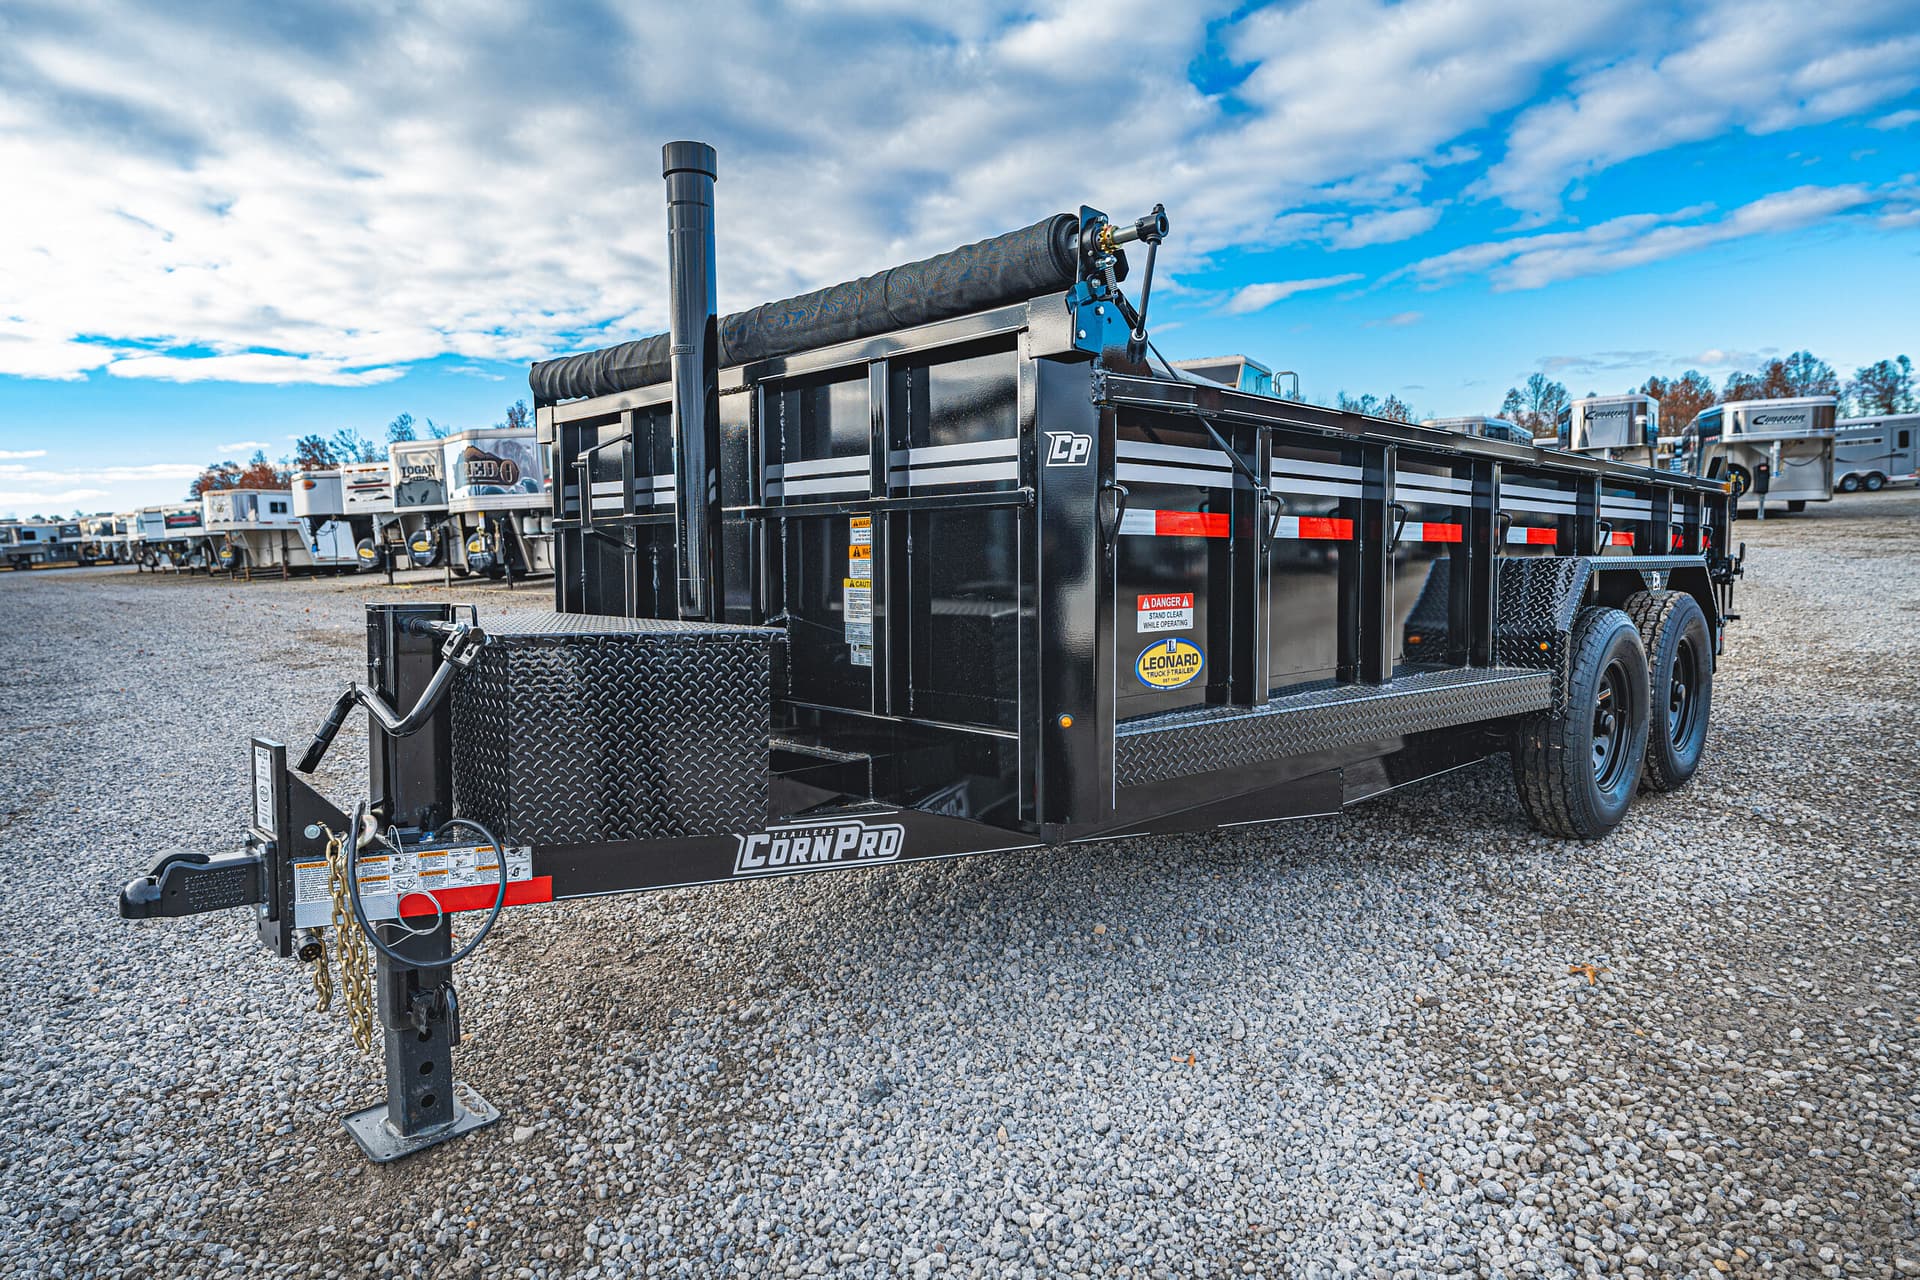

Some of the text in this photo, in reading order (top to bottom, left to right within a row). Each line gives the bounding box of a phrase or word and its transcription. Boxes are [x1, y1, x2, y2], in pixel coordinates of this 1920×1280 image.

[1050, 433, 1089, 464] CP
[400, 464, 436, 478] LOGAN
[1151, 597, 1181, 608] DANGER
[1148, 610, 1183, 620] STAND CLEAR
[1143, 619, 1188, 629] WHILE OPERATING
[1142, 653, 1199, 671] LEONARD
[1146, 669, 1166, 678] TRUCK
[1171, 667, 1194, 675] TRAILER
[773, 828, 836, 840] TRAILERS
